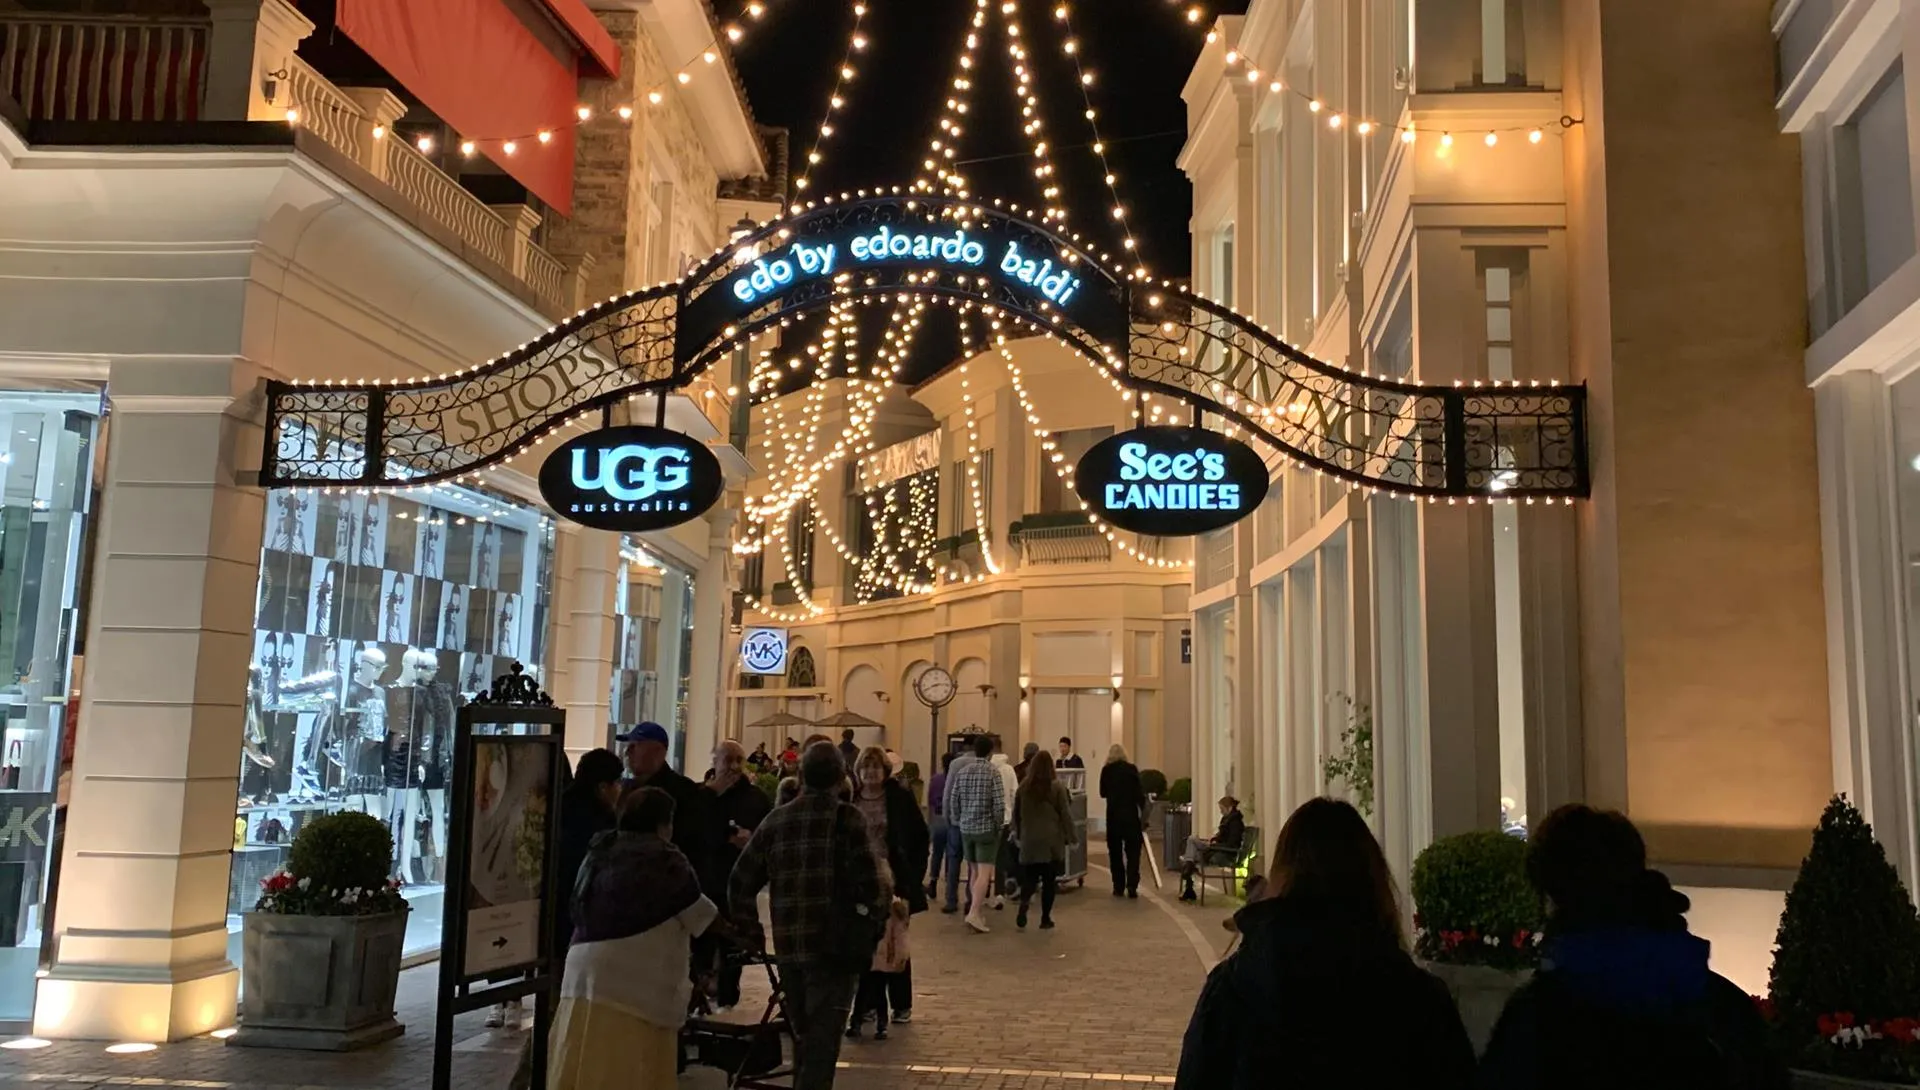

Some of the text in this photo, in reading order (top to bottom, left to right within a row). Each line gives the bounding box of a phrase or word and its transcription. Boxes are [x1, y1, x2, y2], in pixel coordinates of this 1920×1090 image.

[733, 225, 1081, 306] edo by edoardo baldi
[455, 348, 605, 443] SHOPS
[1192, 332, 1376, 449] DINING
[571, 444, 689, 501] UGG
[1119, 442, 1225, 481] See's
[570, 500, 689, 513] australia
[1105, 483, 1240, 510] CANDIES
